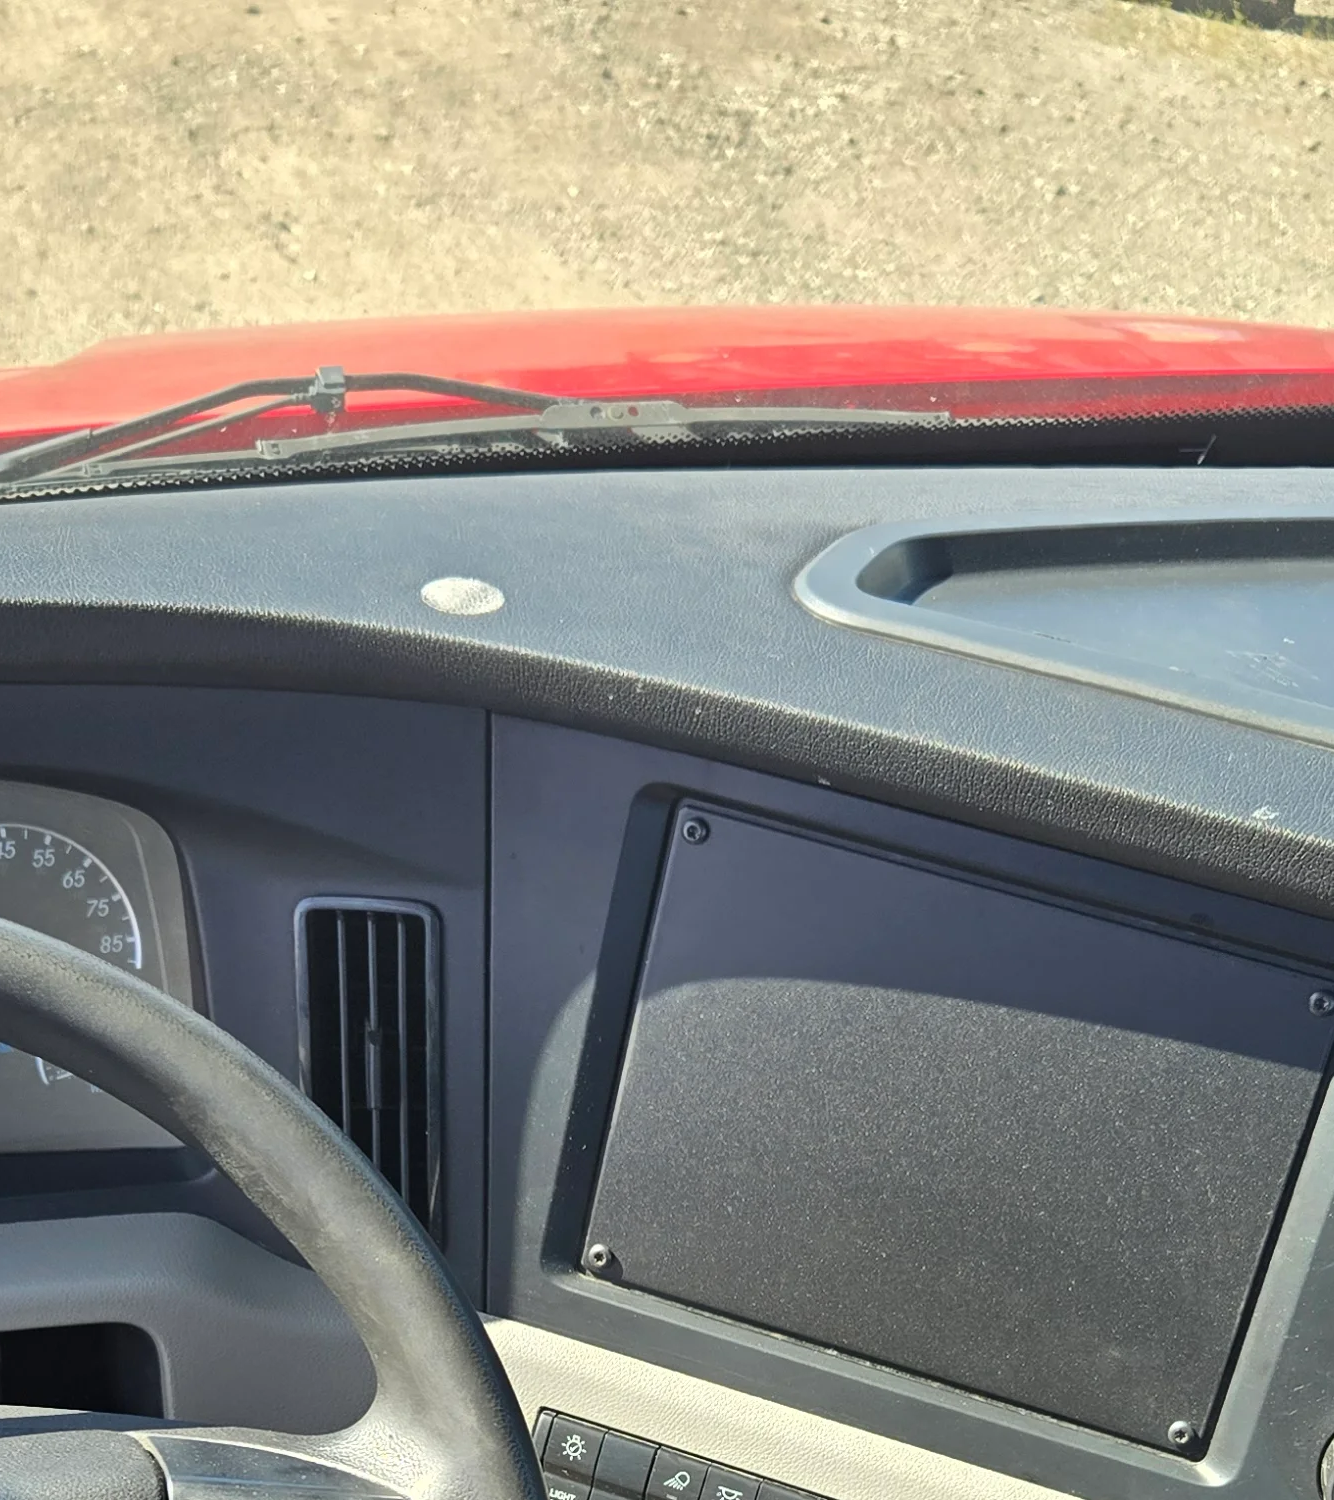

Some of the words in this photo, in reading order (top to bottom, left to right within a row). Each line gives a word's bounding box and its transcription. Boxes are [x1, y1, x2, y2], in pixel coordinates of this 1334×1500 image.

[32, 848, 55, 867] 55
[62, 870, 86, 888] 65
[86, 899, 110, 917] 75
[100, 935, 124, 953] 85
